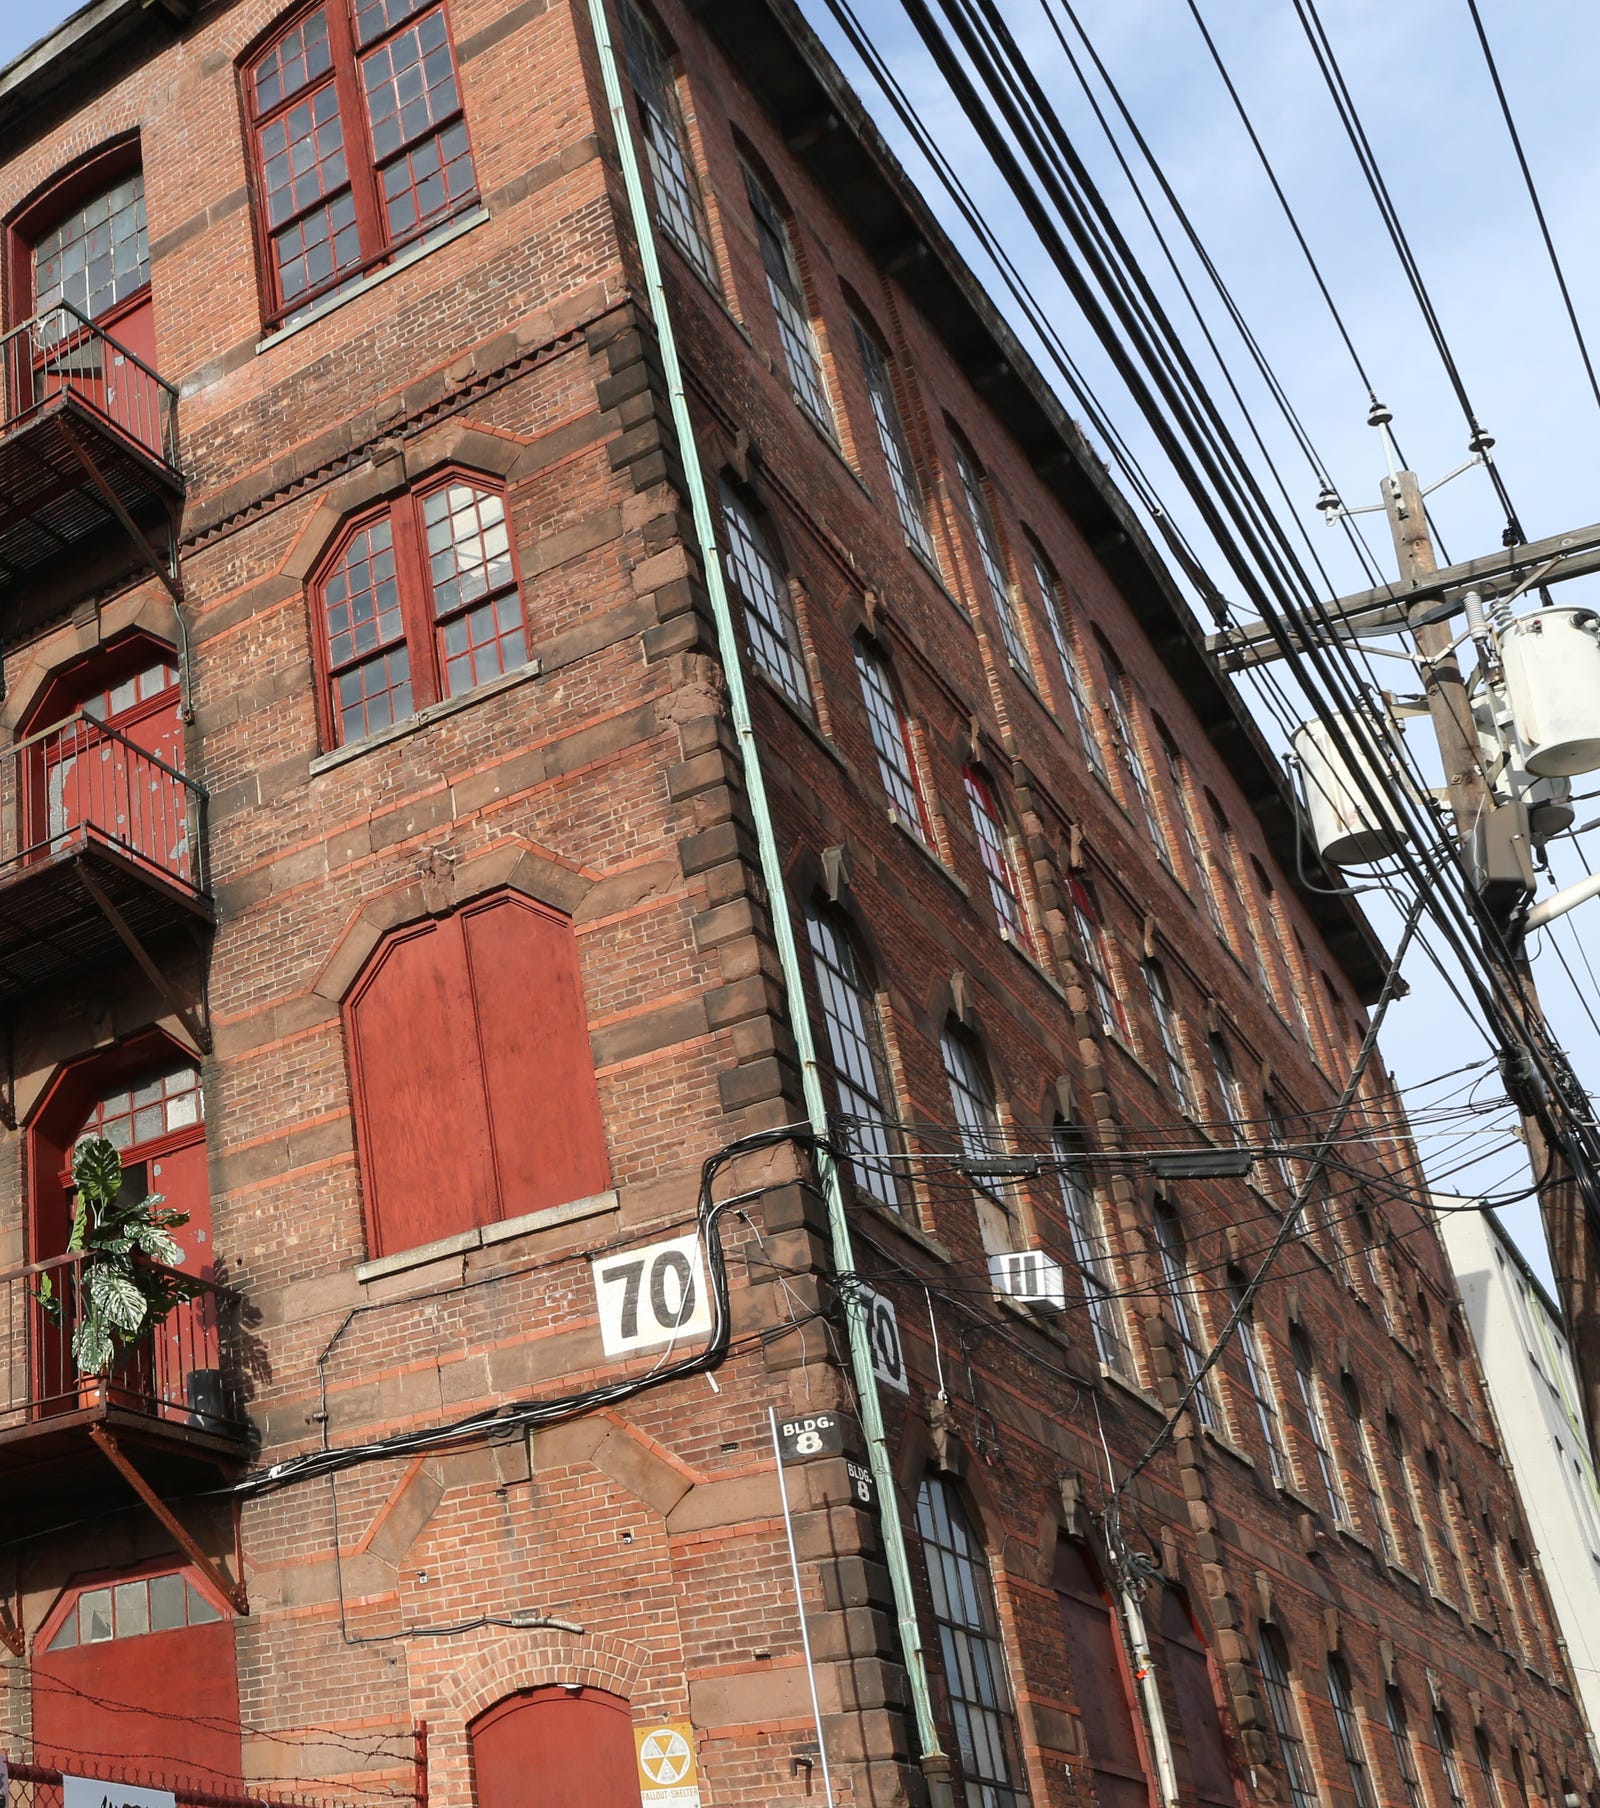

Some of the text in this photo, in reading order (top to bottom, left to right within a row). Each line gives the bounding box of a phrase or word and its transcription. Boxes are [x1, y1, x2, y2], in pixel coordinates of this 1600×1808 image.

[602, 1250, 696, 1339] 70
[782, 1416, 835, 1437] BLDG.
[796, 1431, 824, 1454] 8
[847, 1463, 873, 1484] BLDG.
[857, 1480, 870, 1502] 8
[642, 1787, 698, 1801] FALLOUT SHELTER
